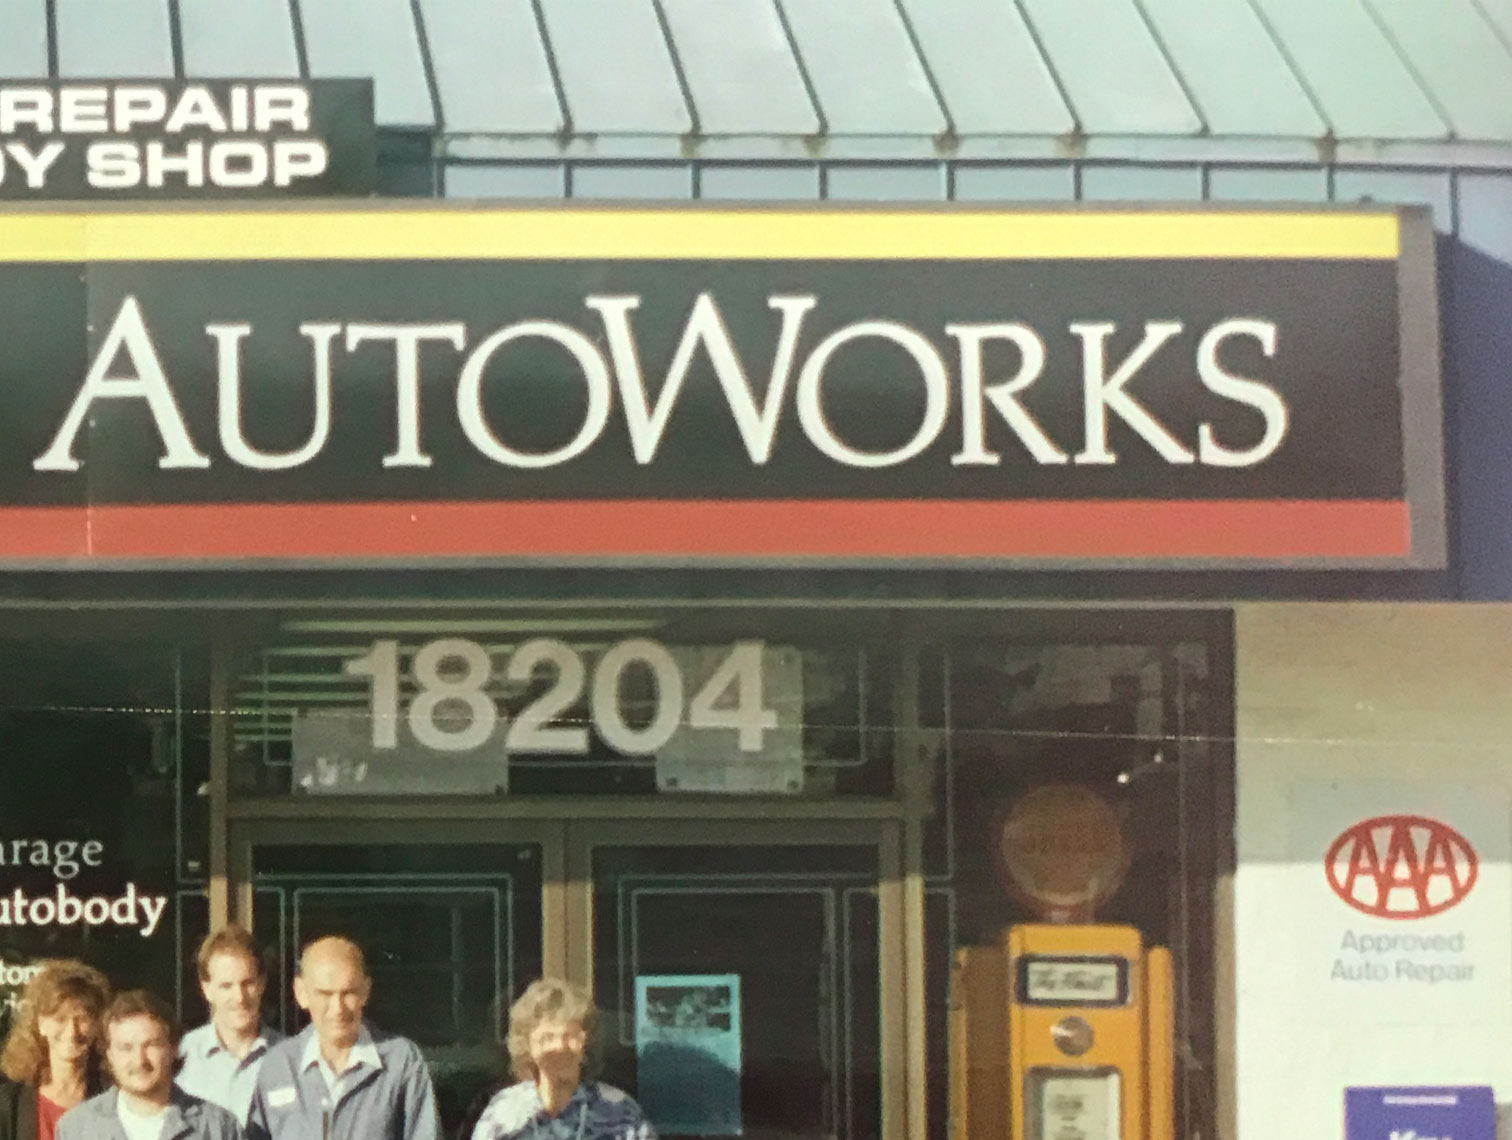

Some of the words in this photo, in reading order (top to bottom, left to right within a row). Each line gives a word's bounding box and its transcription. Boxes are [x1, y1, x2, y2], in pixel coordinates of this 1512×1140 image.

[85, 140, 328, 189] SHOP
[343, 637, 779, 755] 18204
[1328, 816, 1476, 918] AAA
[1341, 929, 1465, 954] Approved
[1331, 958, 1388, 983] Auto
[1395, 958, 1476, 985] Repair
